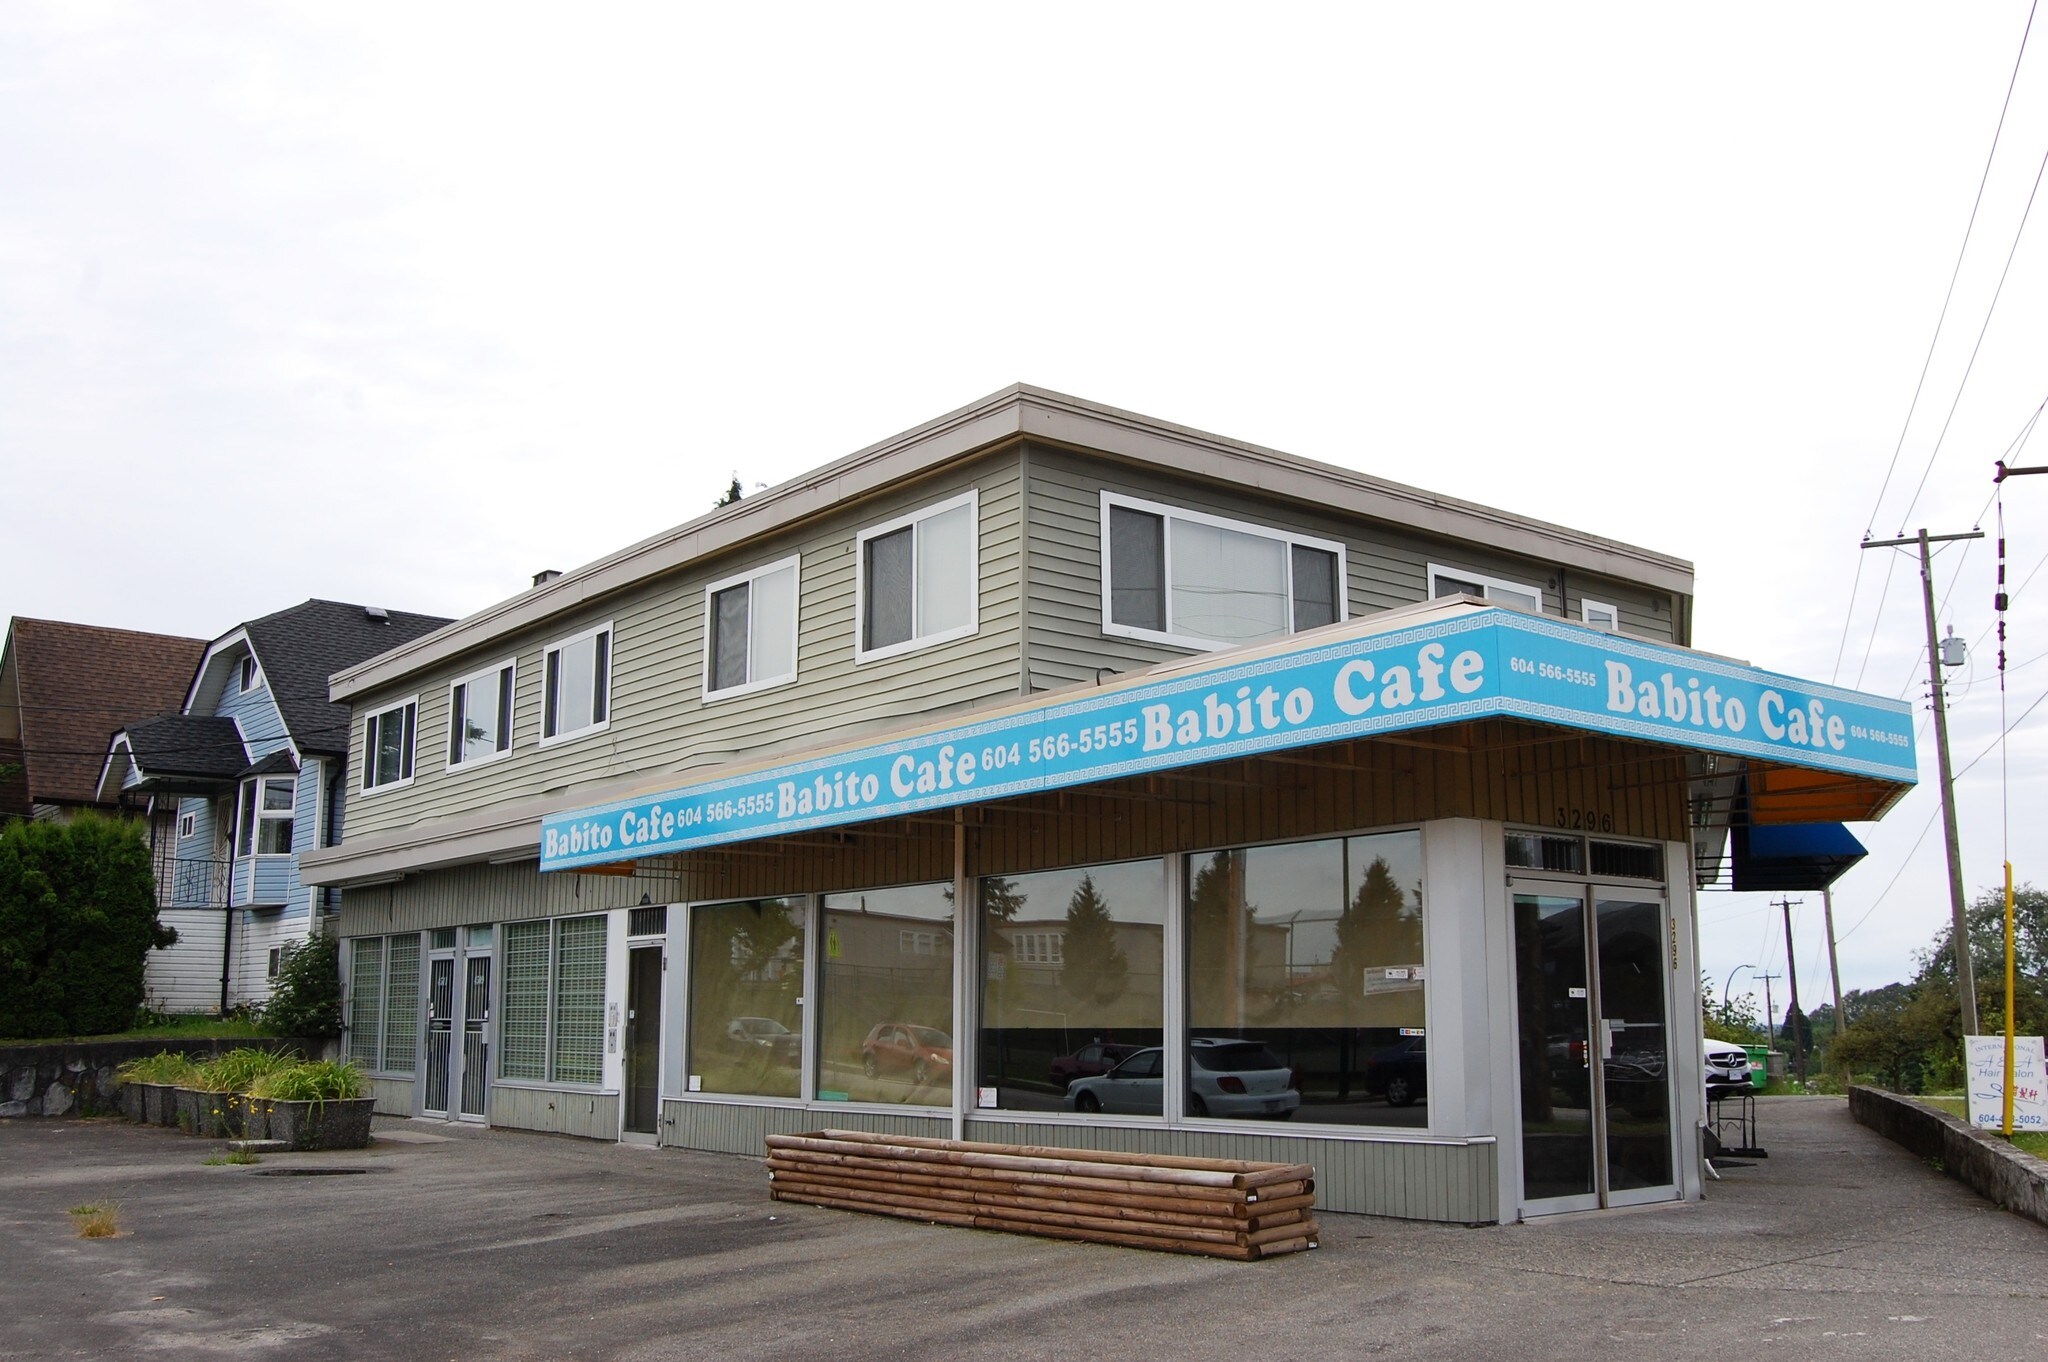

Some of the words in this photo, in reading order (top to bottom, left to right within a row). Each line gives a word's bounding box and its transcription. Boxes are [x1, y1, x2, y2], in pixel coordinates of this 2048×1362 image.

[1510, 657, 1535, 675] 604
[1539, 661, 1597, 687] 566-5555
[1605, 659, 1746, 733] Babito
[1758, 690, 1846, 751] Cafe
[1851, 725, 1868, 740] 604
[1869, 727, 1909, 748] 566-5555
[544, 822, 612, 859] Babito
[619, 805, 674, 846] Cafe
[677, 806, 702, 827] 604
[706, 792, 774, 823] 566-5555
[777, 771, 880, 819] Babito
[890, 745, 977, 797] Cafe
[981, 743, 1021, 772] 604
[1028, 718, 1139, 763] 566-5555
[1142, 685, 1314, 752] Babito
[1333, 642, 1485, 716] Cafe
[1557, 807, 1612, 833] 3296
[1670, 918, 1678, 970] 3296
[1975, 1043, 2035, 1054] INTERNONAL
[1979, 1068, 2001, 1077] Hair
[2012, 1069, 2034, 1078] alon
[1978, 1113, 2042, 1125] 604-4-5052
